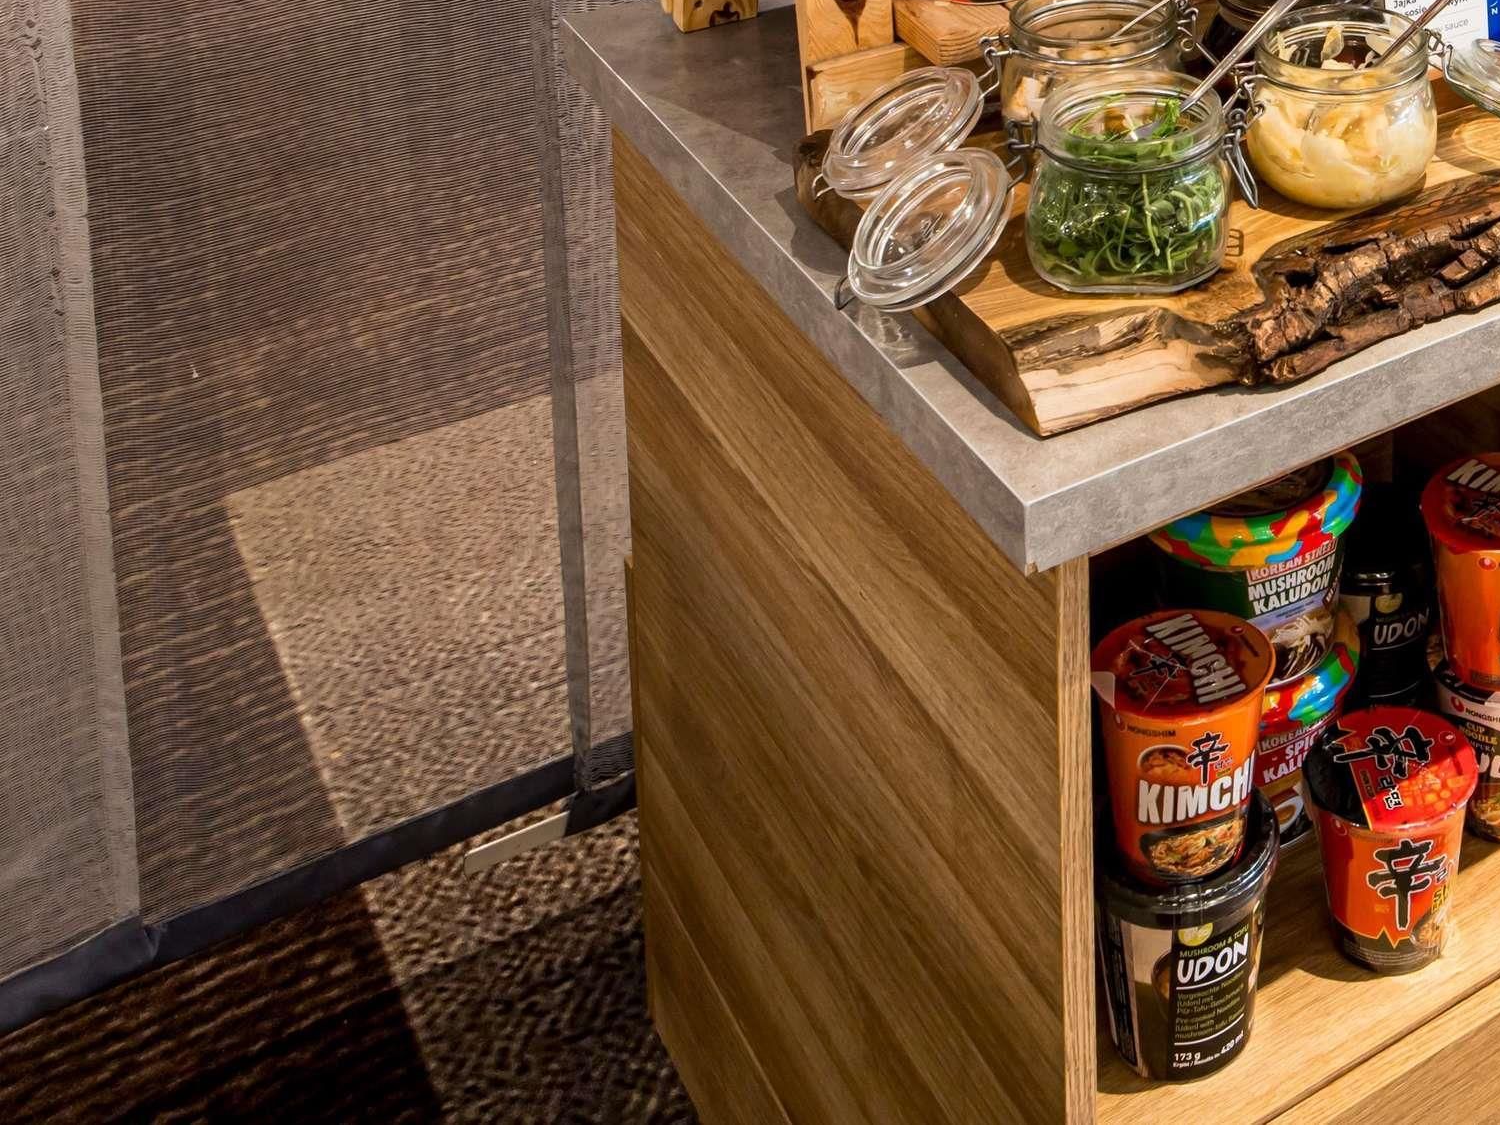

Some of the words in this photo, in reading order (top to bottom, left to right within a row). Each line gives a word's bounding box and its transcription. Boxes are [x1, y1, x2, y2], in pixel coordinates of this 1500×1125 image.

[1444, 18, 1469, 31] sauce
[1247, 553, 1335, 601] MUSHROOM
[1252, 571, 1331, 616] KALUDON
[1374, 606, 1430, 644] UDON
[1146, 613, 1247, 704] KIMCHI
[1138, 749, 1256, 824] KIMCHI
[1366, 838, 1448, 931] 辛
[1177, 932, 1249, 984] UDON
[1179, 940, 1226, 958] MUSHROOM
[1174, 1053, 1193, 1062] 173
[1194, 1052, 1201, 1062] g
